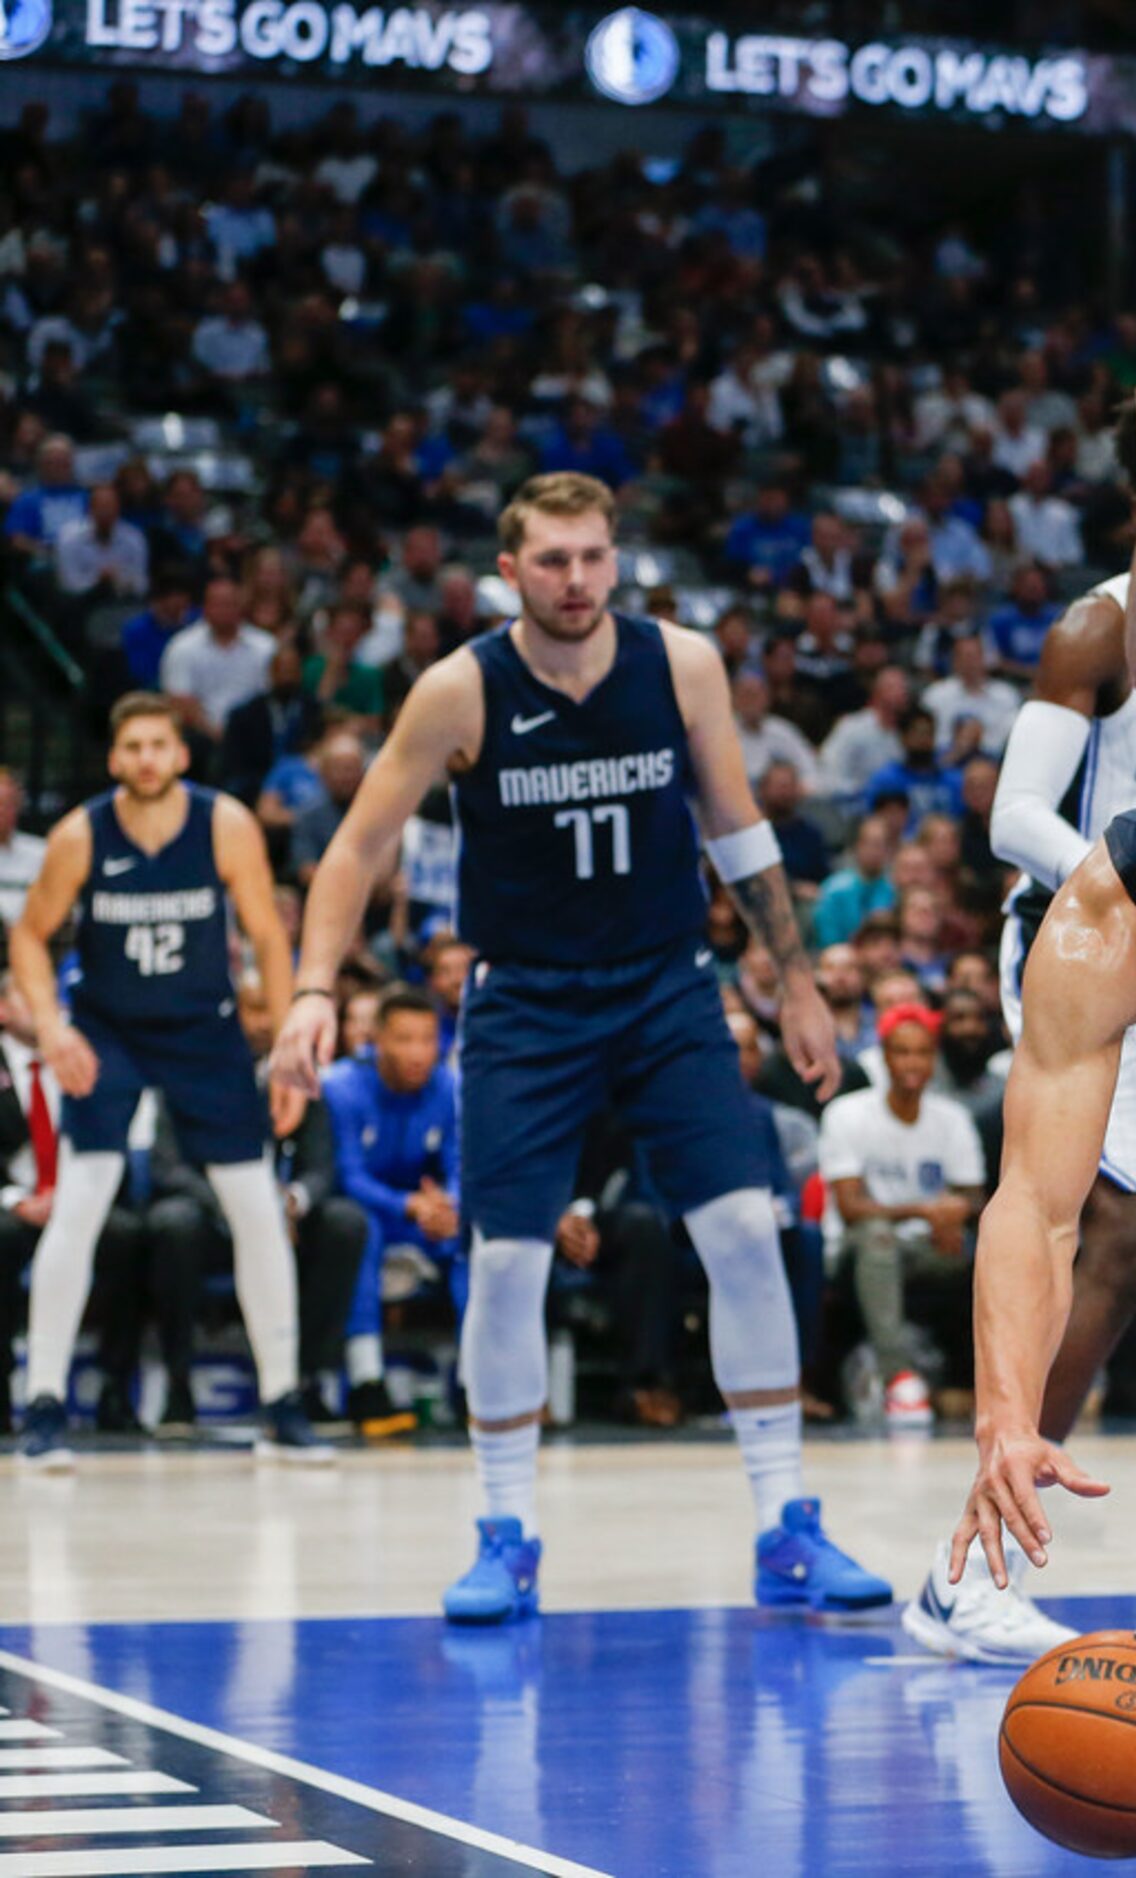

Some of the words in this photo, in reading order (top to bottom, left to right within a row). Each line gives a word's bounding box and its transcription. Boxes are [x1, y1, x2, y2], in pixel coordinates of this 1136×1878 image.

[240, 0, 328, 61] GO
[330, 3, 492, 74] MAVS
[851, 42, 933, 107] GO
[935, 48, 1089, 121] MAVS
[498, 747, 675, 808] MAVERICKS
[553, 803, 631, 880] 77
[124, 921, 185, 977] 42
